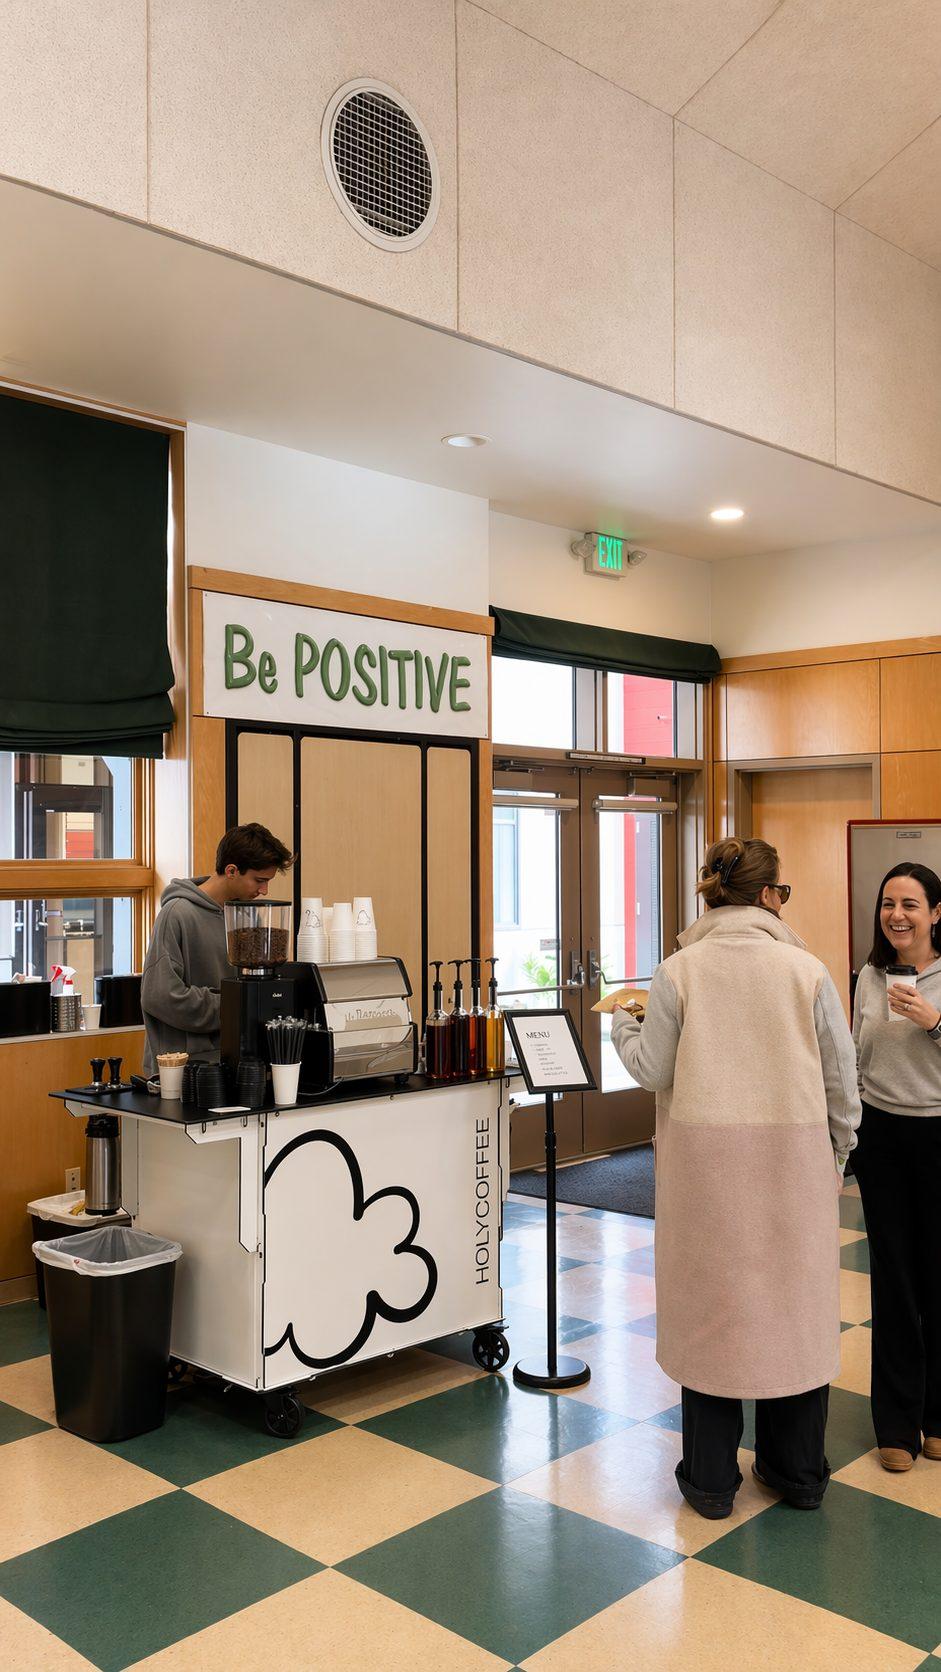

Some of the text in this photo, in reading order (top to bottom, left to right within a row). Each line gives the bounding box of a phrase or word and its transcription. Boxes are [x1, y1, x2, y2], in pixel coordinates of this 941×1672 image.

[598, 535, 624, 571] EXIT
[224, 623, 472, 713] Be POSITIVE
[525, 1031, 551, 1039] MENU
[475, 1117, 490, 1285] HOLYCOFFEE
